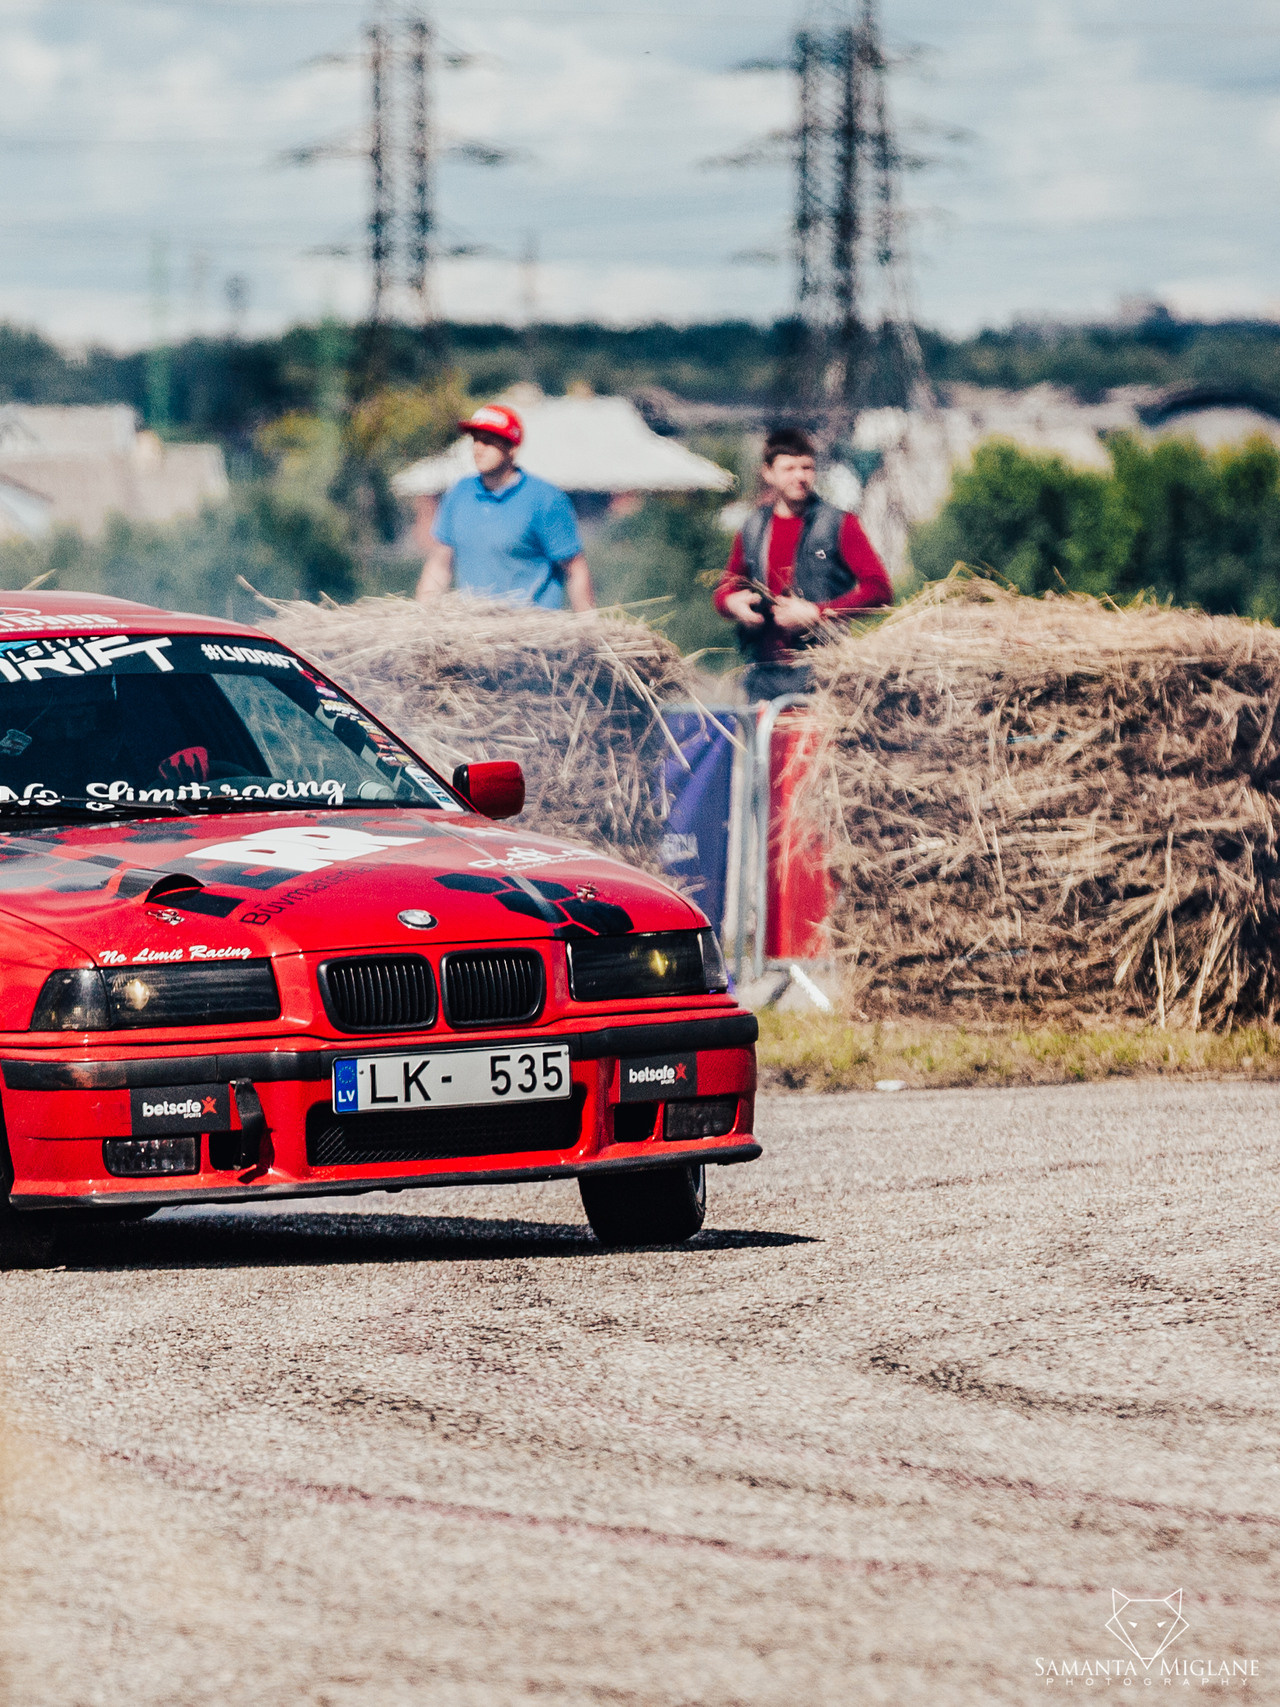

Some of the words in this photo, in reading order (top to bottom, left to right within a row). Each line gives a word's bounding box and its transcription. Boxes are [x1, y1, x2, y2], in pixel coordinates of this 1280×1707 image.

[6, 636, 101, 663] Latvi
[200, 643, 304, 672] #LVDRIFT
[99, 950, 127, 964] No
[132, 947, 183, 962] Limit
[189, 945, 252, 960] Racing
[490, 1051, 563, 1096] 535
[629, 1064, 676, 1083] betsafe
[338, 1090, 355, 1103] LV
[142, 1099, 202, 1118] betsafe
